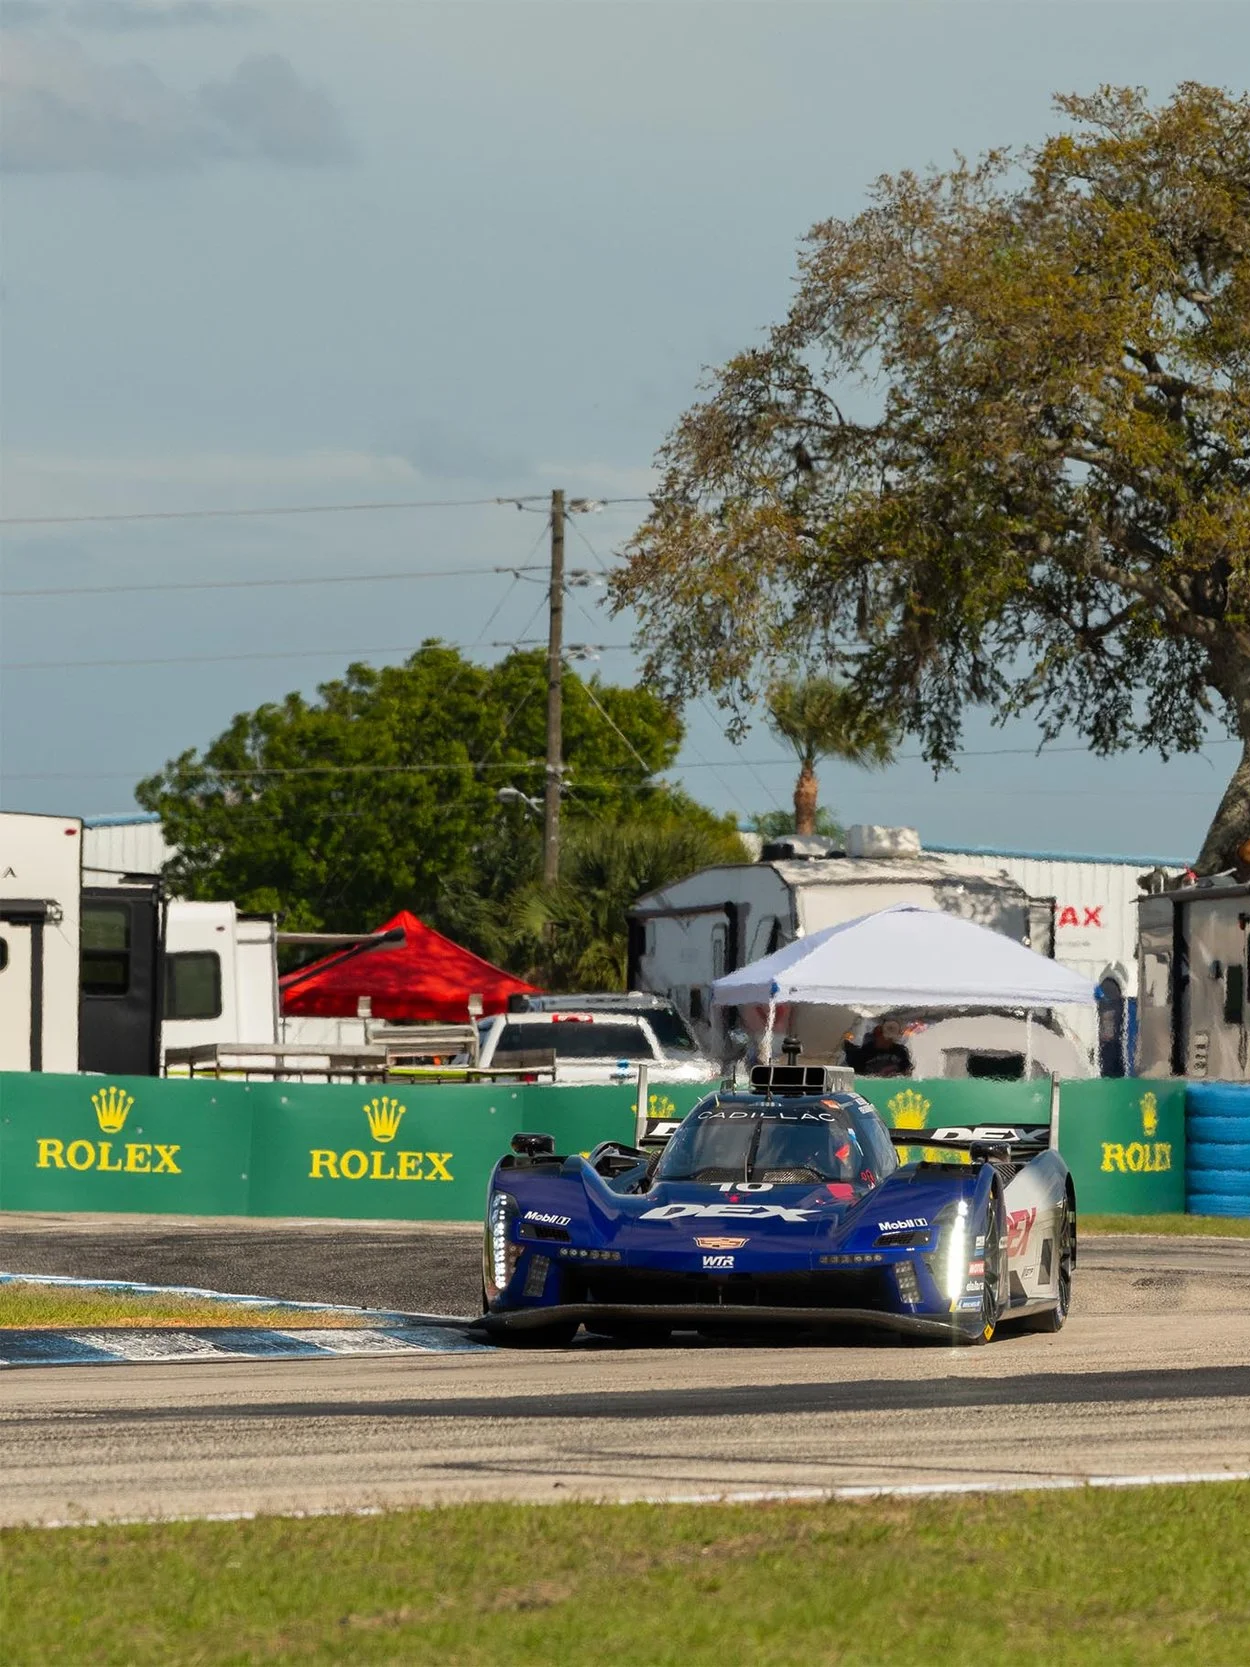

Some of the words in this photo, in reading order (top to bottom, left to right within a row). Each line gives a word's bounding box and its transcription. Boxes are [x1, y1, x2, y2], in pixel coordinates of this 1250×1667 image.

[697, 1111, 836, 1122] CADILLAC
[36, 1138, 182, 1174] ROLEX
[308, 1149, 454, 1181] ROLEX
[710, 1182, 774, 1192] 10
[524, 1211, 557, 1224] Mobil
[639, 1203, 822, 1222] DEX
[878, 1218, 915, 1231] Mobil
[702, 1255, 735, 1266] WTR
